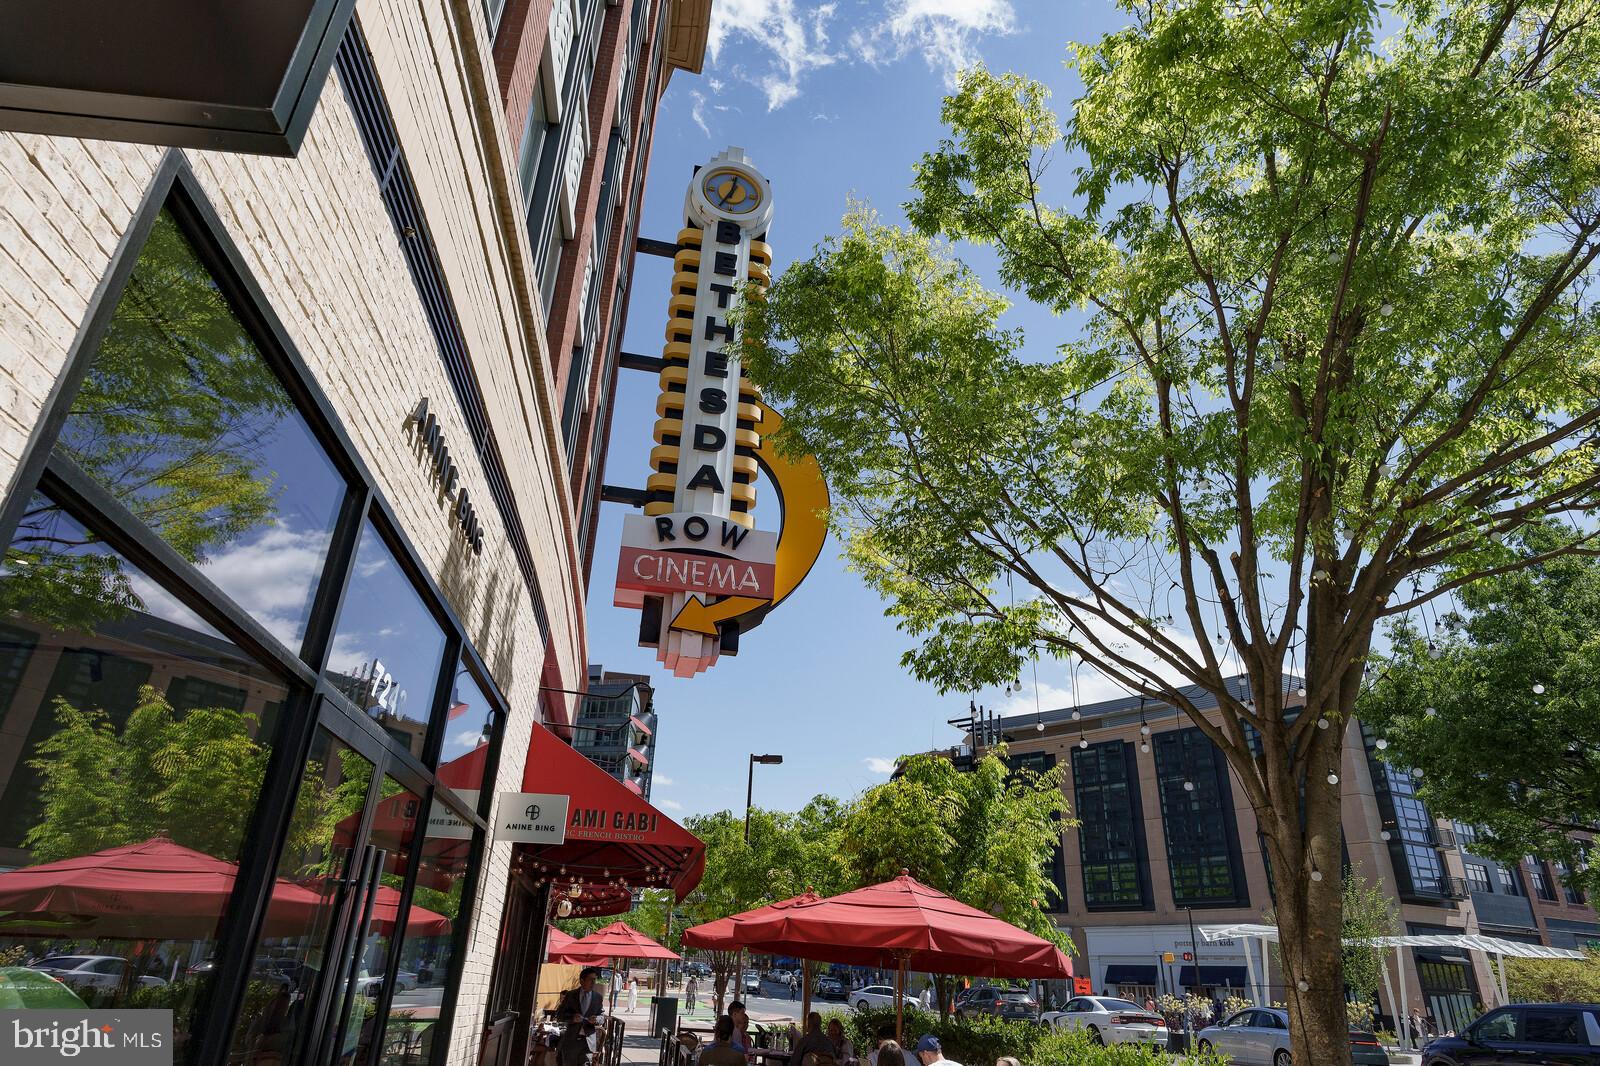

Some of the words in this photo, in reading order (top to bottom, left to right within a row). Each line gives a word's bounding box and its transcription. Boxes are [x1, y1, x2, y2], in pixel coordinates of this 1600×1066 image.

[687, 221, 741, 494] BETHESDA
[655, 516, 749, 550] ROW
[633, 554, 760, 592] CINEMA
[505, 823, 532, 831] ANINE
[535, 824, 556, 832] BING
[571, 808, 606, 829] AMI
[613, 811, 659, 832] GABI
[578, 830, 612, 839] FRENCH
[614, 832, 645, 841] BISTRO
[1219, 938, 1235, 947] kids
